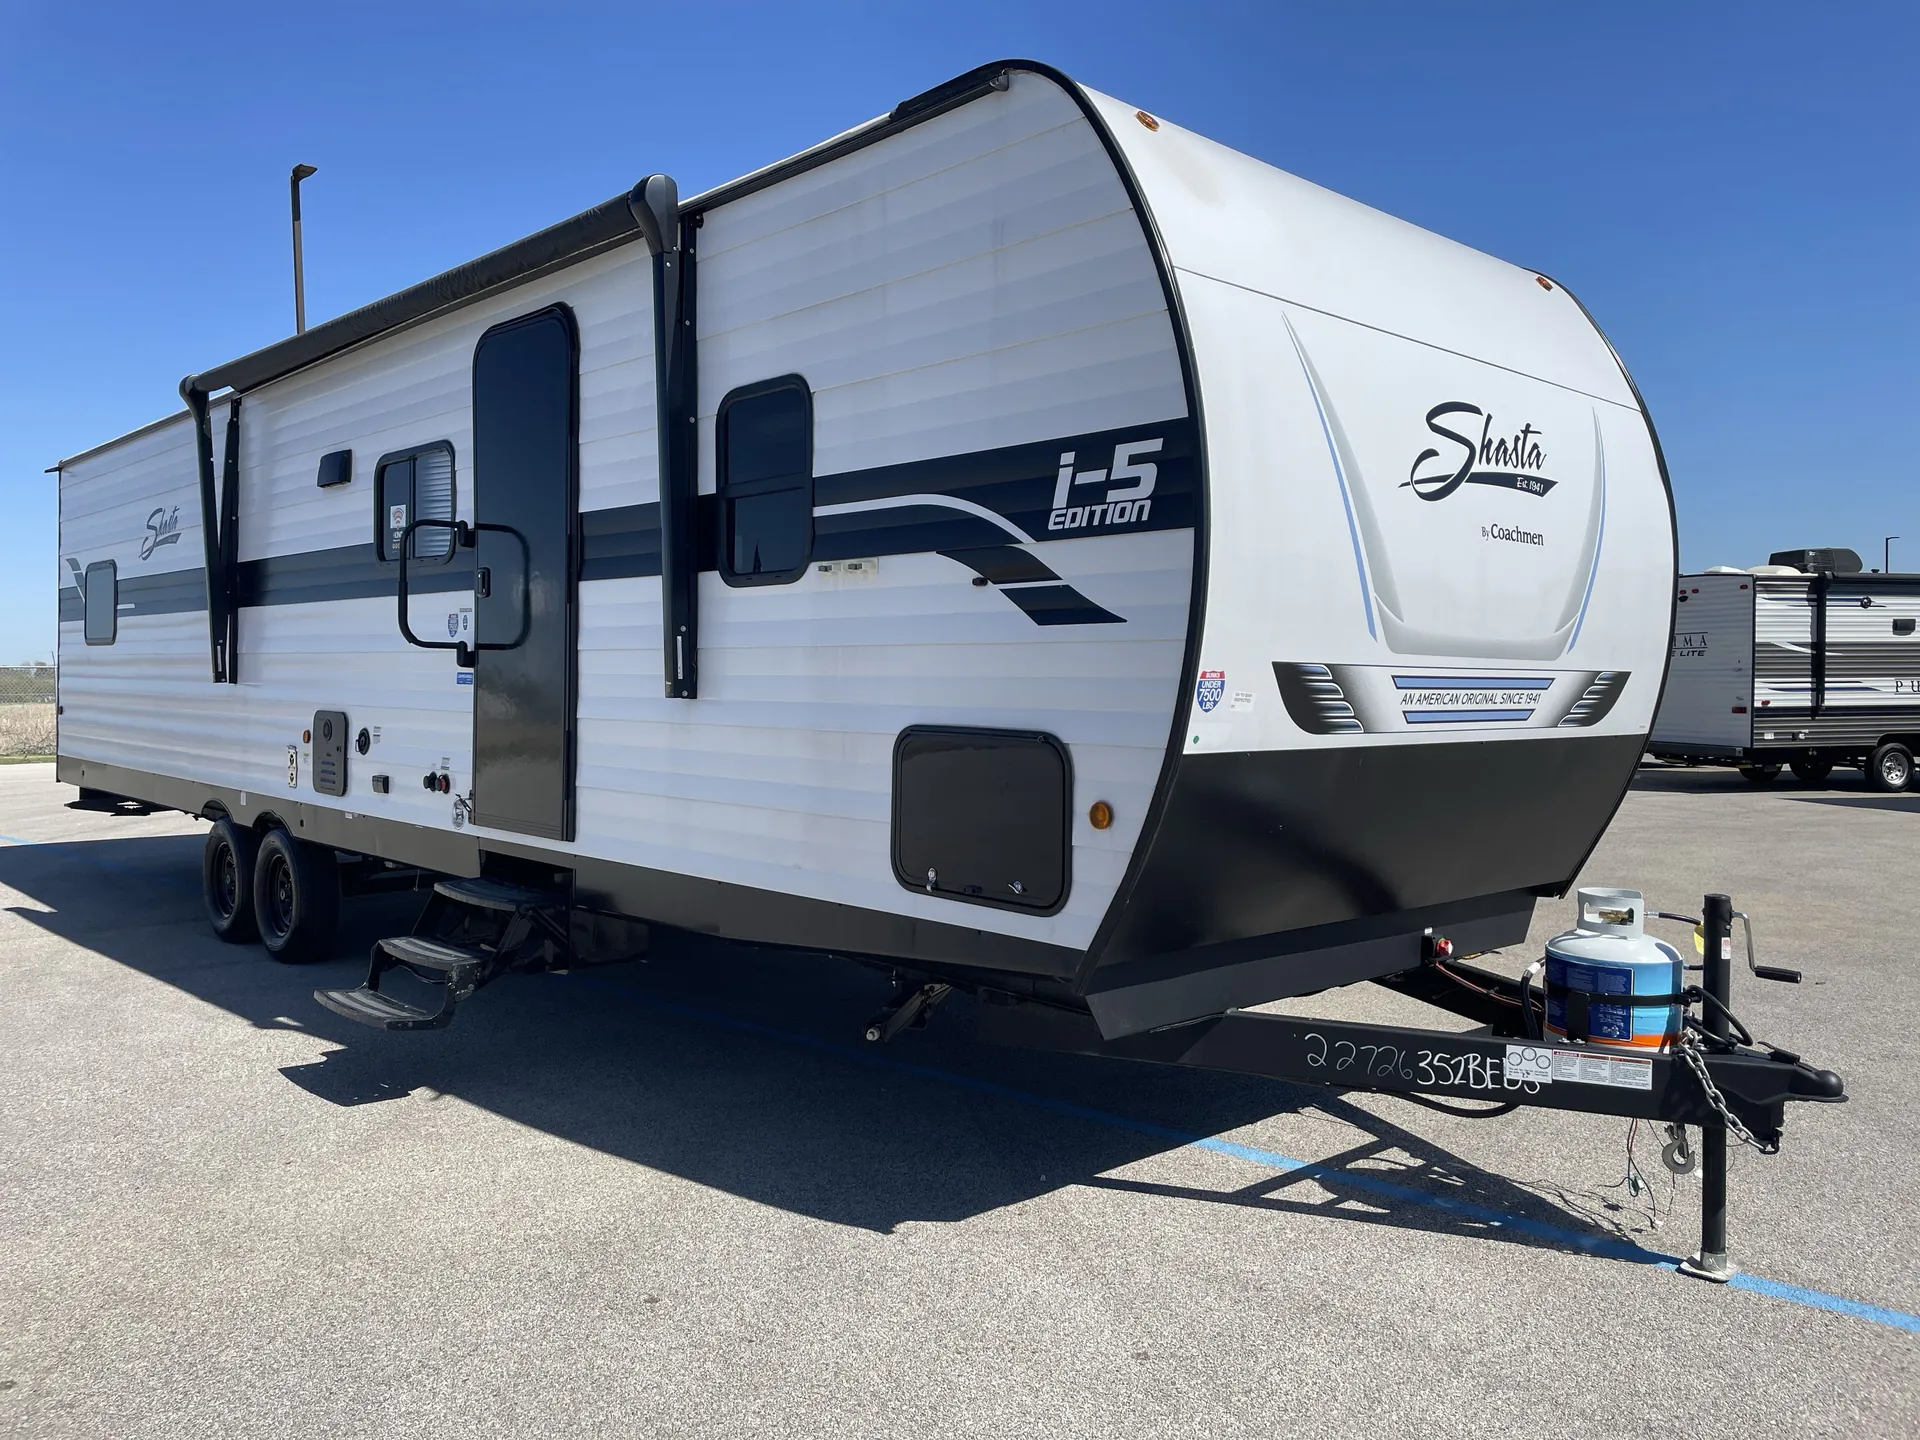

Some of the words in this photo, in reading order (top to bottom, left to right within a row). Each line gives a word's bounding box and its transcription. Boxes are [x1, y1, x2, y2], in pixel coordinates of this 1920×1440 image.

[1409, 400, 1548, 502] Shasta
[1052, 437, 1164, 509] i-5
[1529, 480, 1544, 494] 1941
[1047, 499, 1151, 531] EDITION
[140, 505, 181, 561] Shasta
[1481, 526, 1490, 541] By
[1490, 523, 1545, 546] Coachmen
[1198, 688, 1222, 702] 7500
[1201, 680, 1222, 689] UNDER
[1202, 701, 1215, 710] LBS
[1400, 693, 1415, 705] AN
[1415, 692, 1462, 705] AMERICAN
[1461, 692, 1498, 705] ORIGINAL
[1499, 692, 1525, 705] SINCE
[1524, 692, 1541, 705] 1941
[1304, 1032, 1413, 1080] 22726
